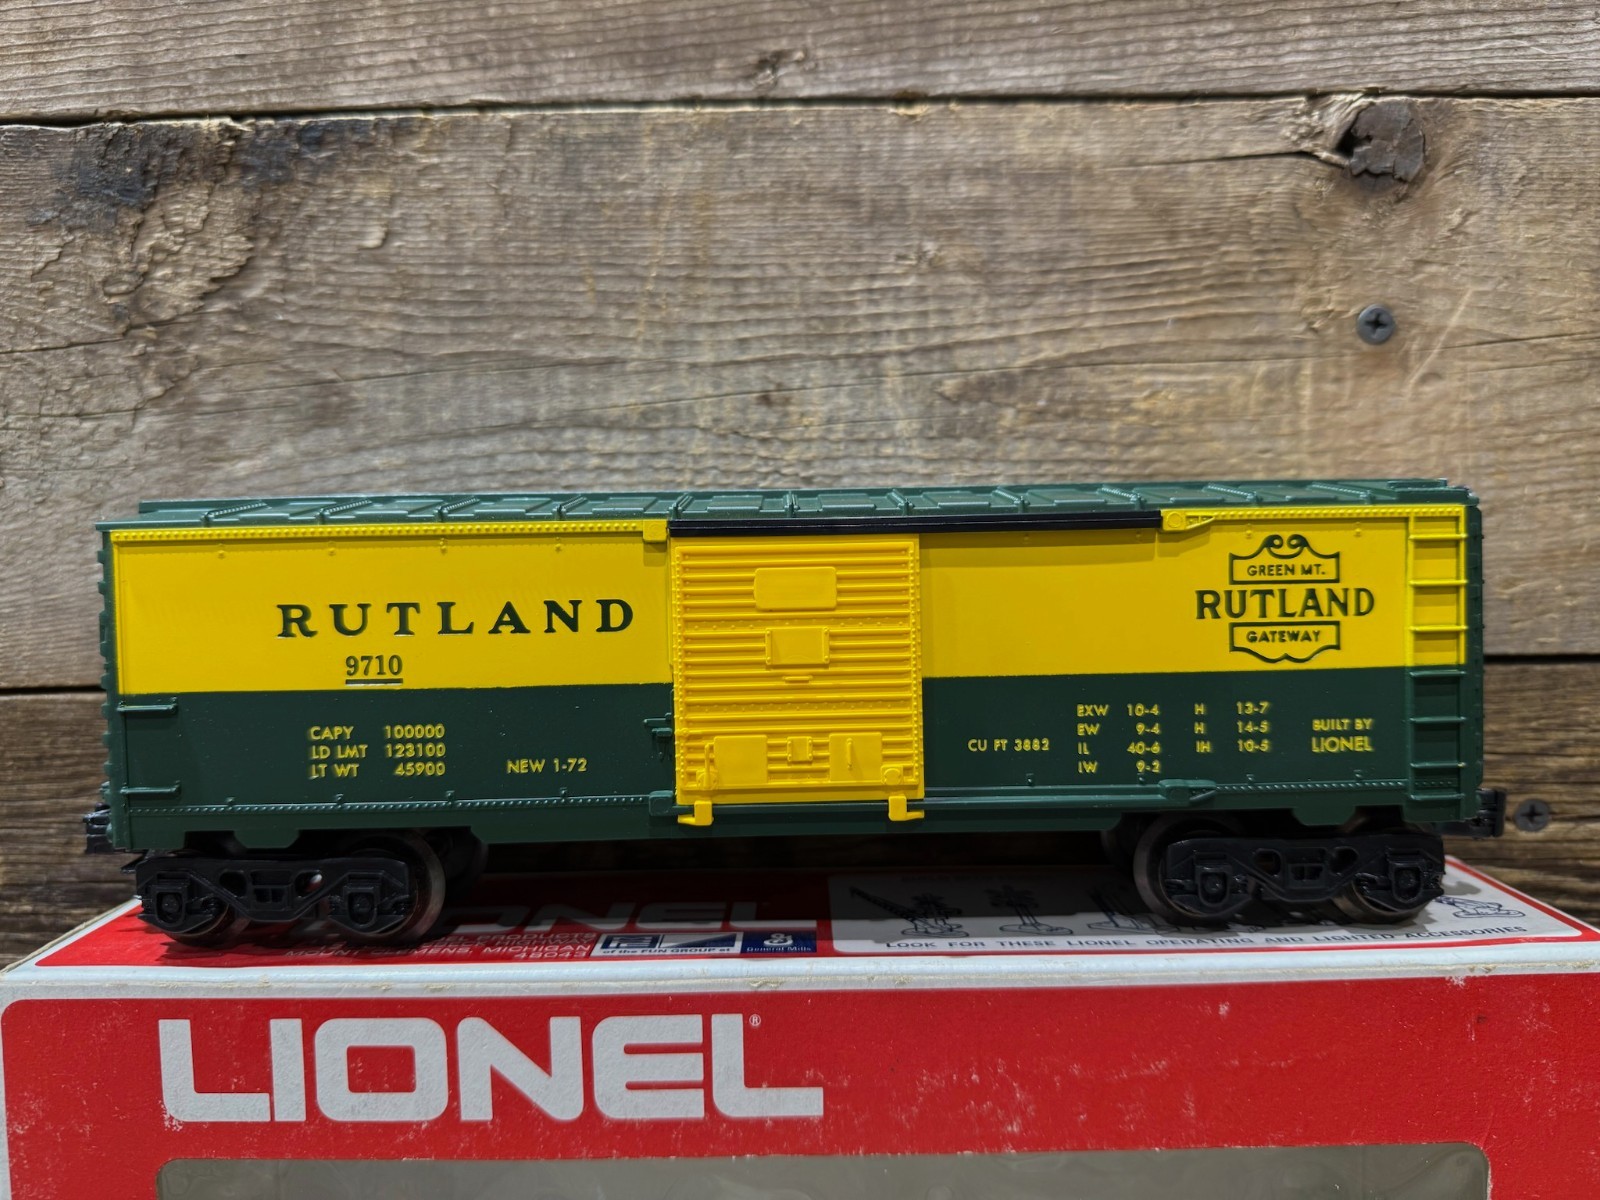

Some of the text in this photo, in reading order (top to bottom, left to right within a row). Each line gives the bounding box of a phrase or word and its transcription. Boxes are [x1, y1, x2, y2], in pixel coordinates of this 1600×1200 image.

[1246, 562, 1326, 577] GREEN MT.
[1195, 586, 1376, 620] RUTLAND
[276, 598, 635, 639] RUTLAND
[1245, 629, 1322, 643] GATEWAY
[345, 654, 403, 677] 9710
[1076, 700, 1270, 717] EXW 10-4 H 13-7
[309, 723, 446, 741] CAPY 100000
[1076, 719, 1270, 736] EW 9-4 H 14-5
[1311, 717, 1374, 732] BUILT BY
[310, 741, 447, 760] LD LMT 123100
[967, 737, 1051, 753] CU FT 3882
[1077, 738, 1270, 755] IL 40-6 IH 10-5
[1311, 735, 1376, 754] LIONEL
[308, 760, 447, 780] LT WT 45900
[506, 756, 588, 775] NEW 1-72
[1077, 759, 1162, 774] IW 9-2
[476, 932, 598, 942] PRODUCTS
[495, 937, 593, 947] HIGHWAY
[886, 941, 936, 949] LOOK
[995, 940, 1056, 948] THESE
[1065, 939, 1136, 947] LIONEL
[1145, 937, 1254, 946] OPERATING
[1311, 933, 1395, 942] LIGHTED
[1404, 926, 1528, 938] ACCESSORIES
[482, 944, 592, 954] MICHIGAN
[512, 950, 588, 960] 48043
[640, 947, 667, 955] FUN
[787, 945, 812, 953] Mills
[157, 1012, 825, 1123] LIONEL
